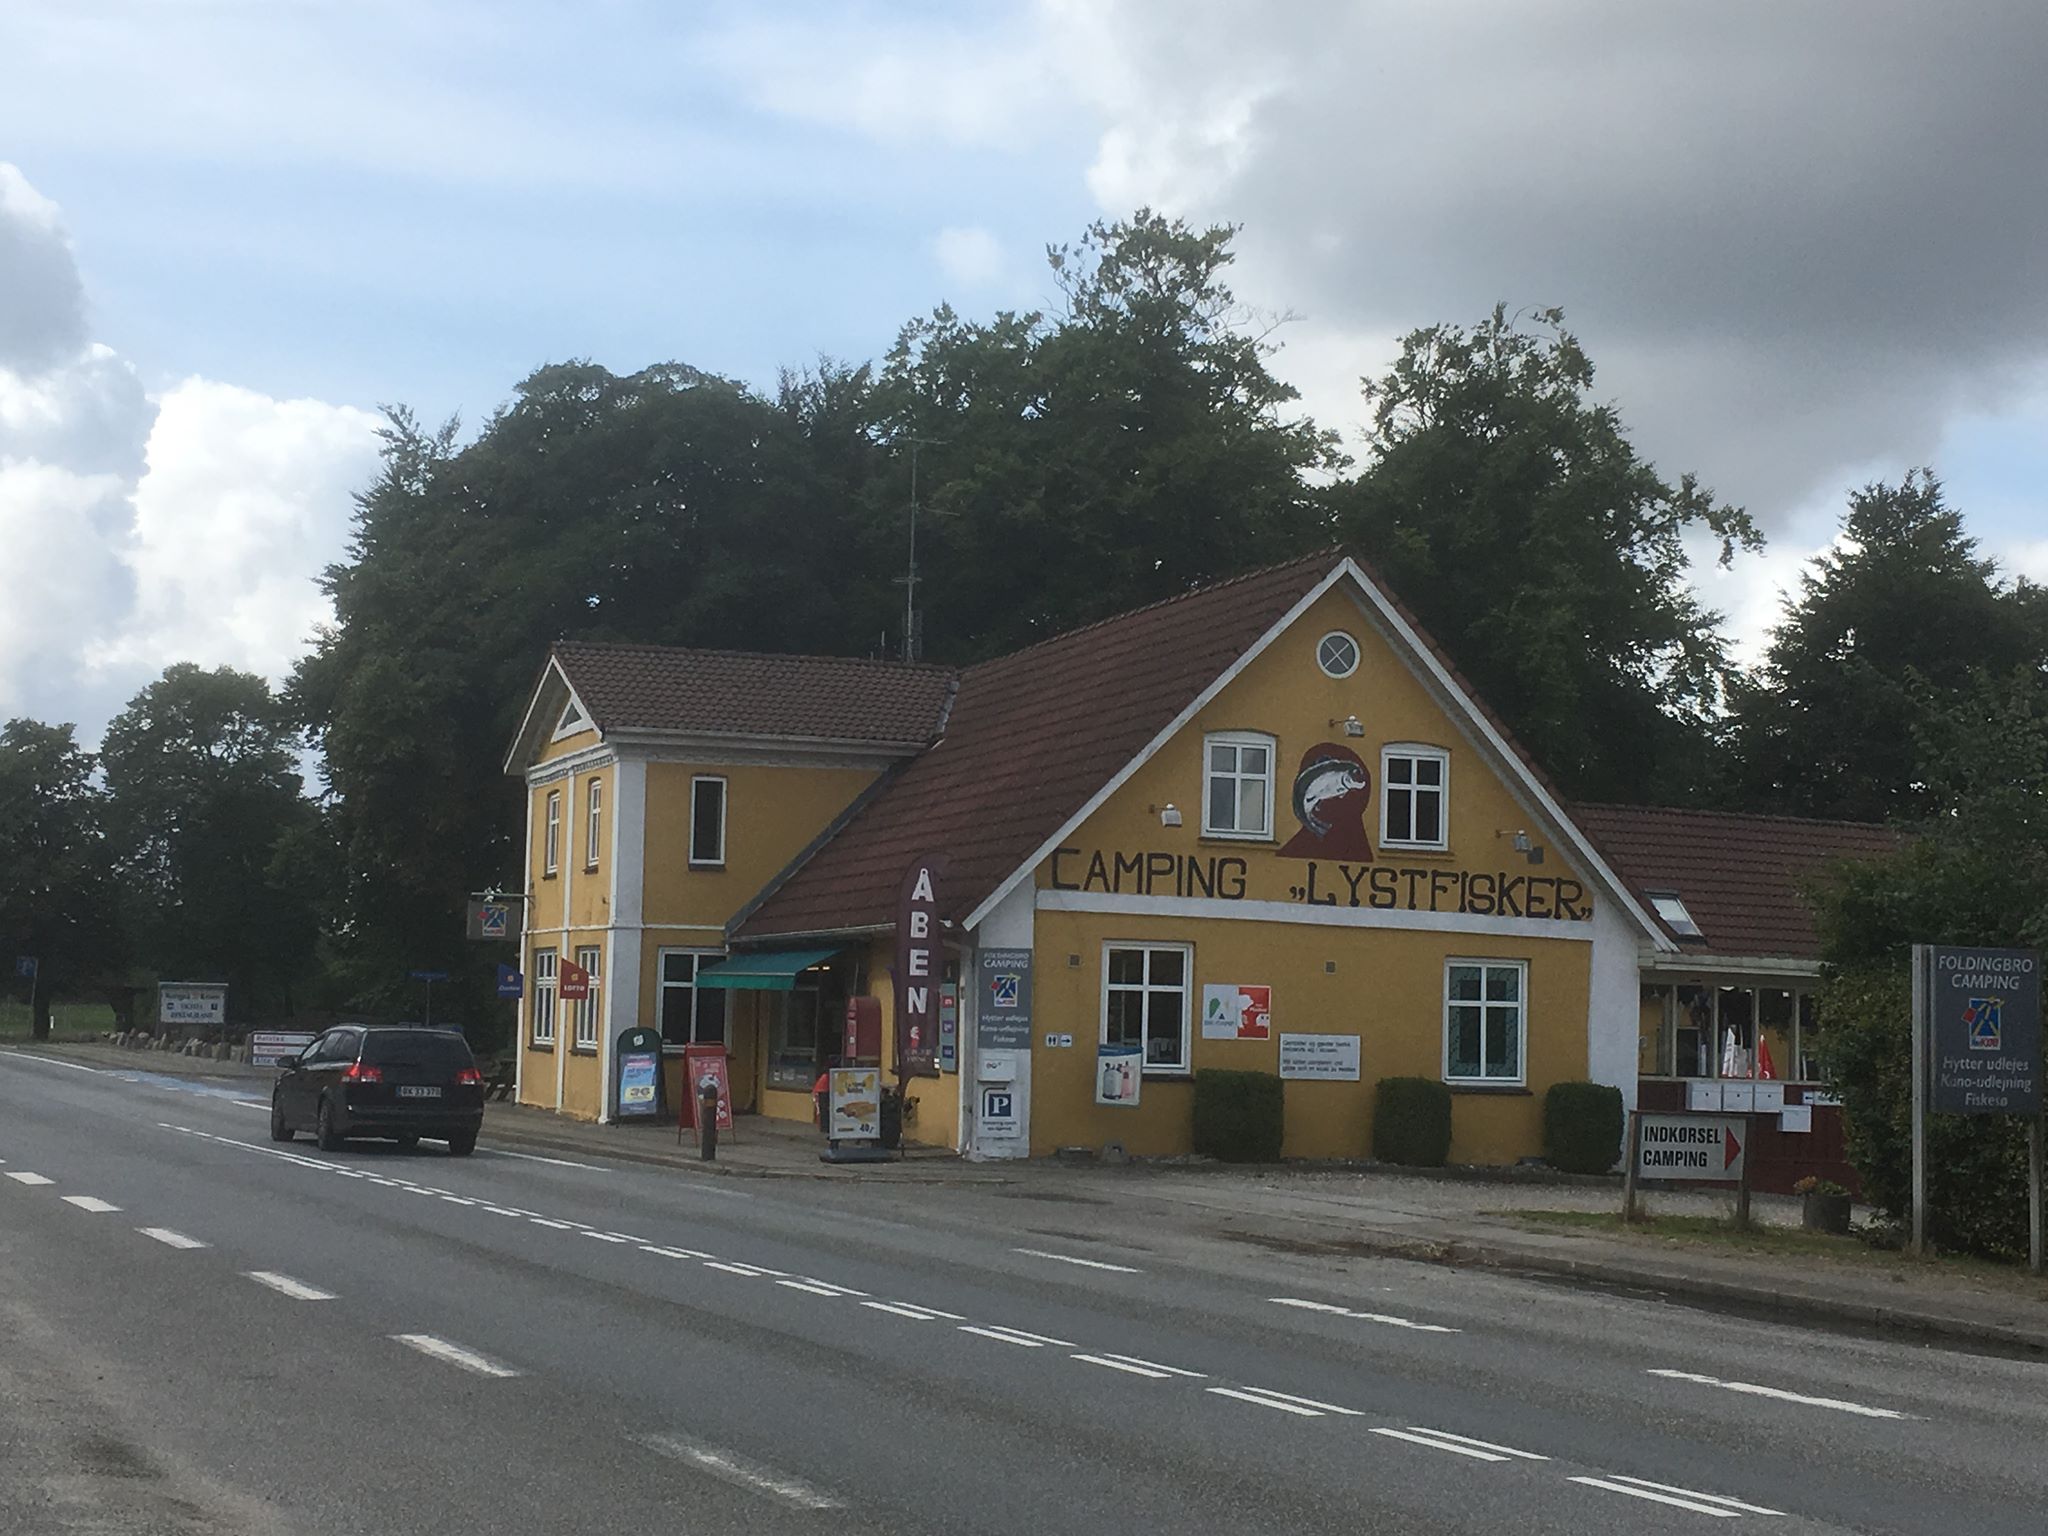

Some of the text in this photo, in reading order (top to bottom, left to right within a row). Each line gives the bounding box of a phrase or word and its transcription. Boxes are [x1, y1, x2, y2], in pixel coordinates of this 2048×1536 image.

[1053, 848, 1248, 900] CAMPING
[983, 959, 1029, 969] CAMPING
[1938, 955, 2033, 973] FOLDINGBRO
[563, 984, 585, 992] LOTTO
[1951, 973, 2021, 991] CAMPING
[1942, 1056, 2029, 1074] Hytter udlejes
[992, 1096, 1009, 1114] P
[1643, 1125, 1721, 1144] INDKØRSEL
[1643, 1149, 1708, 1168] CAMPING
